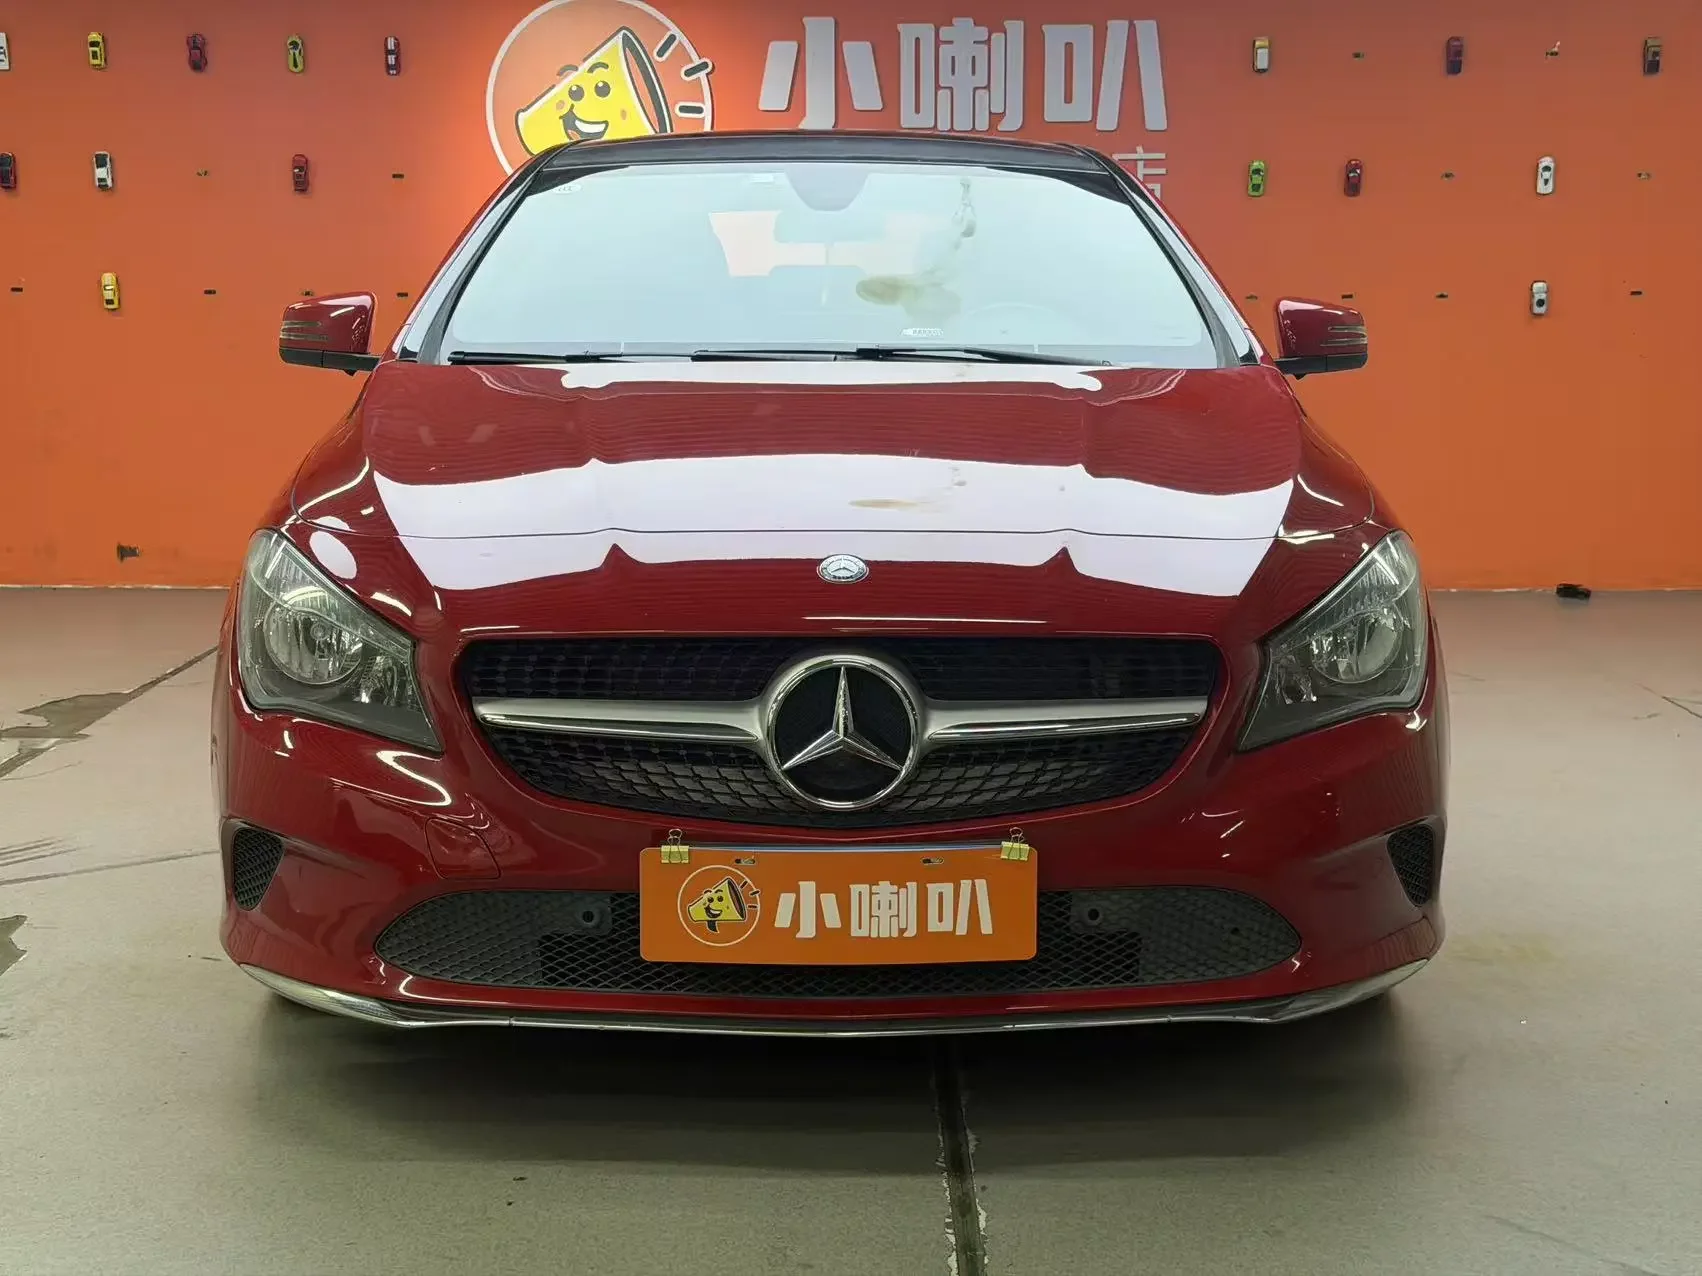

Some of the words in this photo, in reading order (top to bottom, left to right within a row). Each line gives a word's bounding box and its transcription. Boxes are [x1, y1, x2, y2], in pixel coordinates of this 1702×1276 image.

[758, 17, 1168, 131] 小喇叭
[774, 879, 993, 938] 小喇叭
